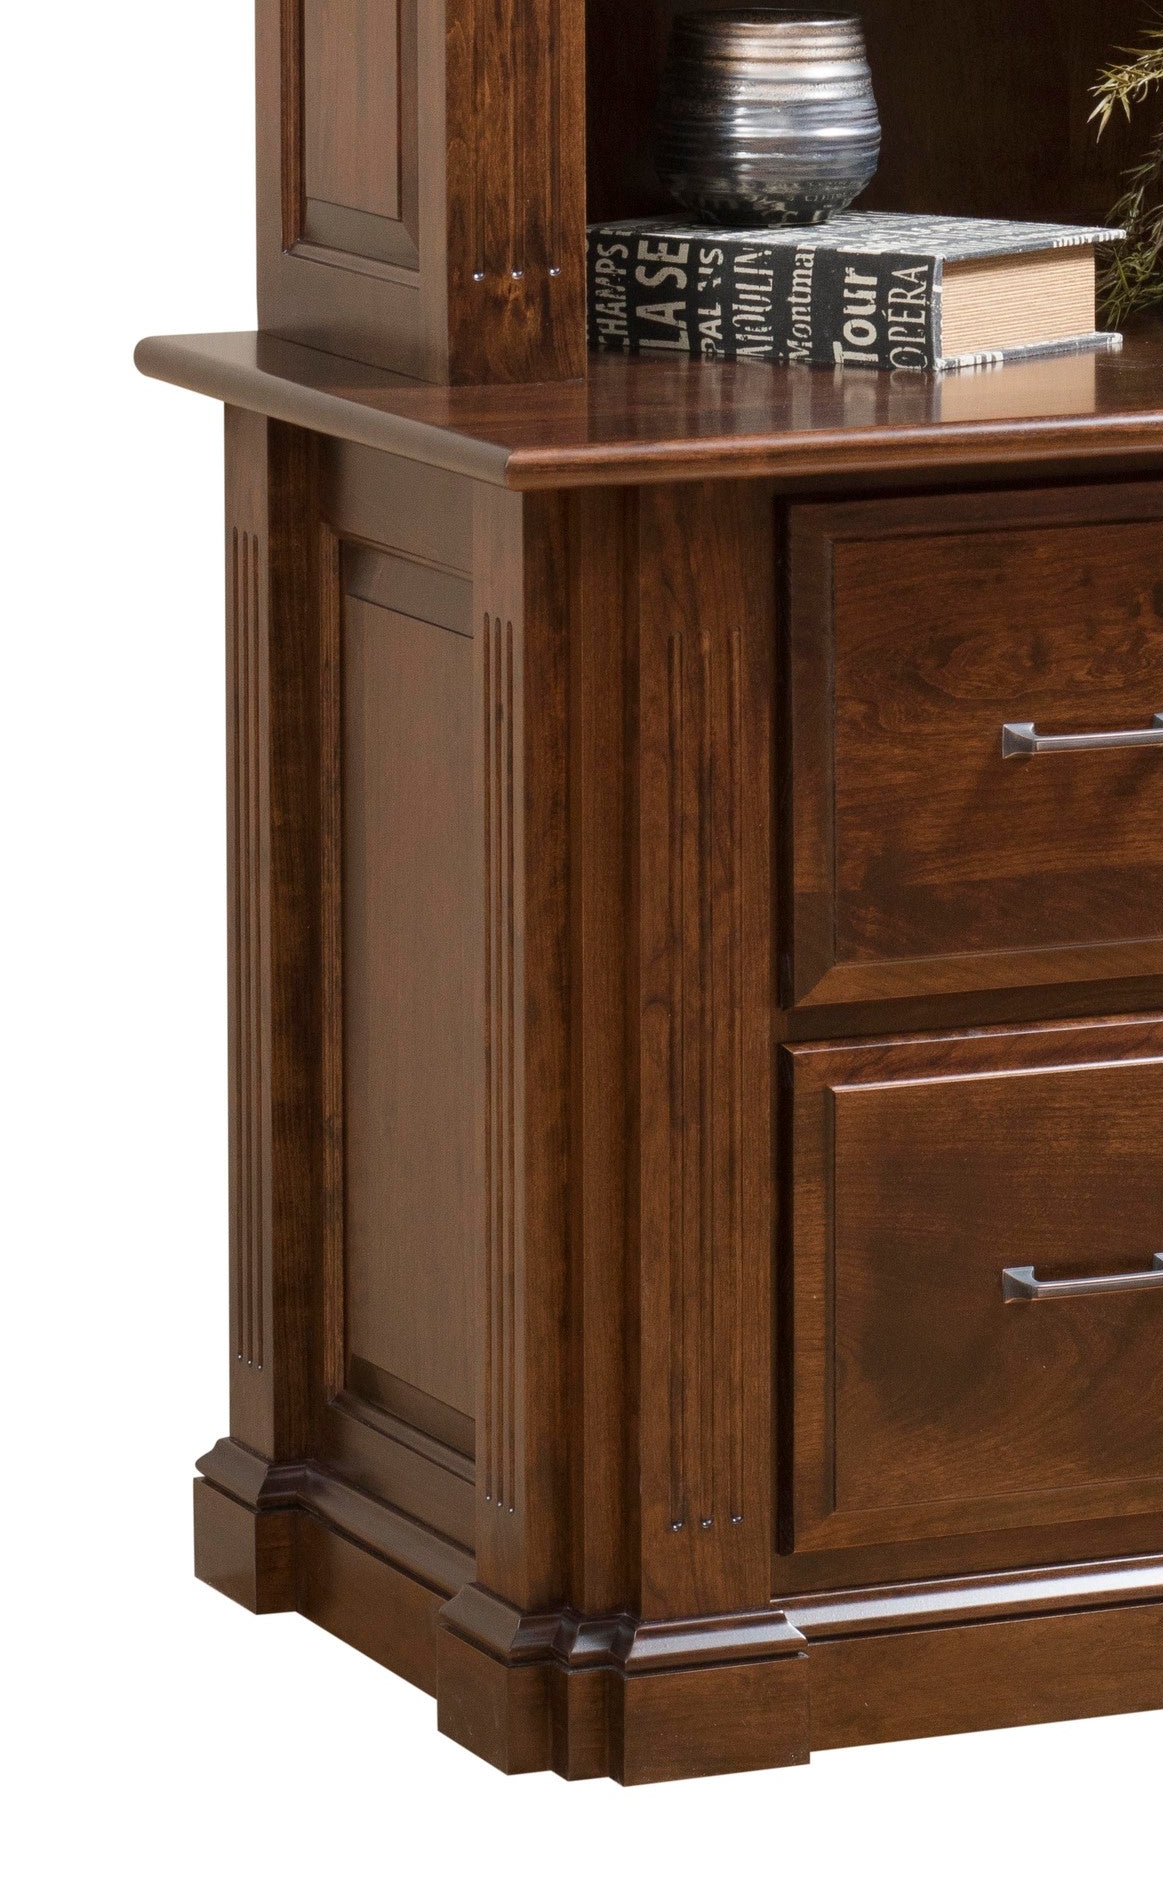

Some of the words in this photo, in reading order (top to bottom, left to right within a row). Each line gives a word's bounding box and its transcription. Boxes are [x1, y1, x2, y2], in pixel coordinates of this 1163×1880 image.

[636, 301, 691, 351] LA
[832, 266, 879, 364] Tour
[881, 264, 930, 370] OPÉRA
